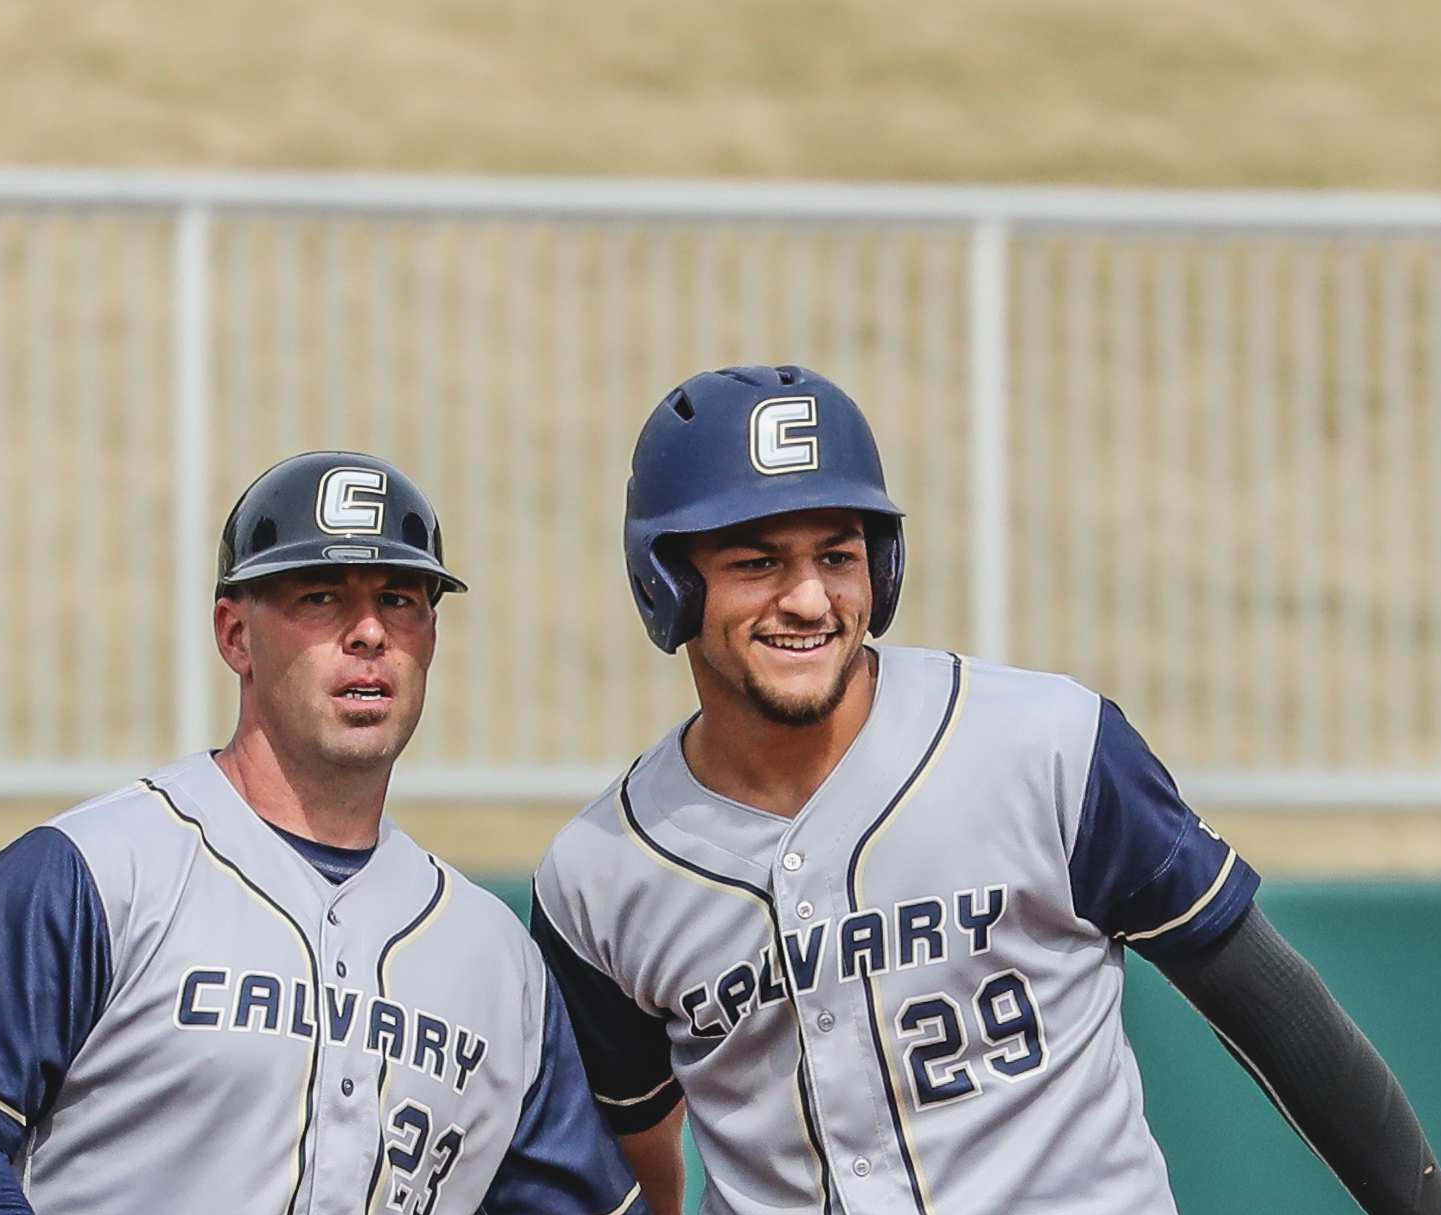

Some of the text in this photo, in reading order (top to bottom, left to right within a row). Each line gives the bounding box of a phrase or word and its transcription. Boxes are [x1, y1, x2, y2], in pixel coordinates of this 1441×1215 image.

[748, 396, 819, 476] C
[315, 466, 388, 535] C
[679, 884, 1008, 1038] CALVARY
[174, 966, 488, 1094] CALVARY
[894, 968, 1051, 1112] 29
